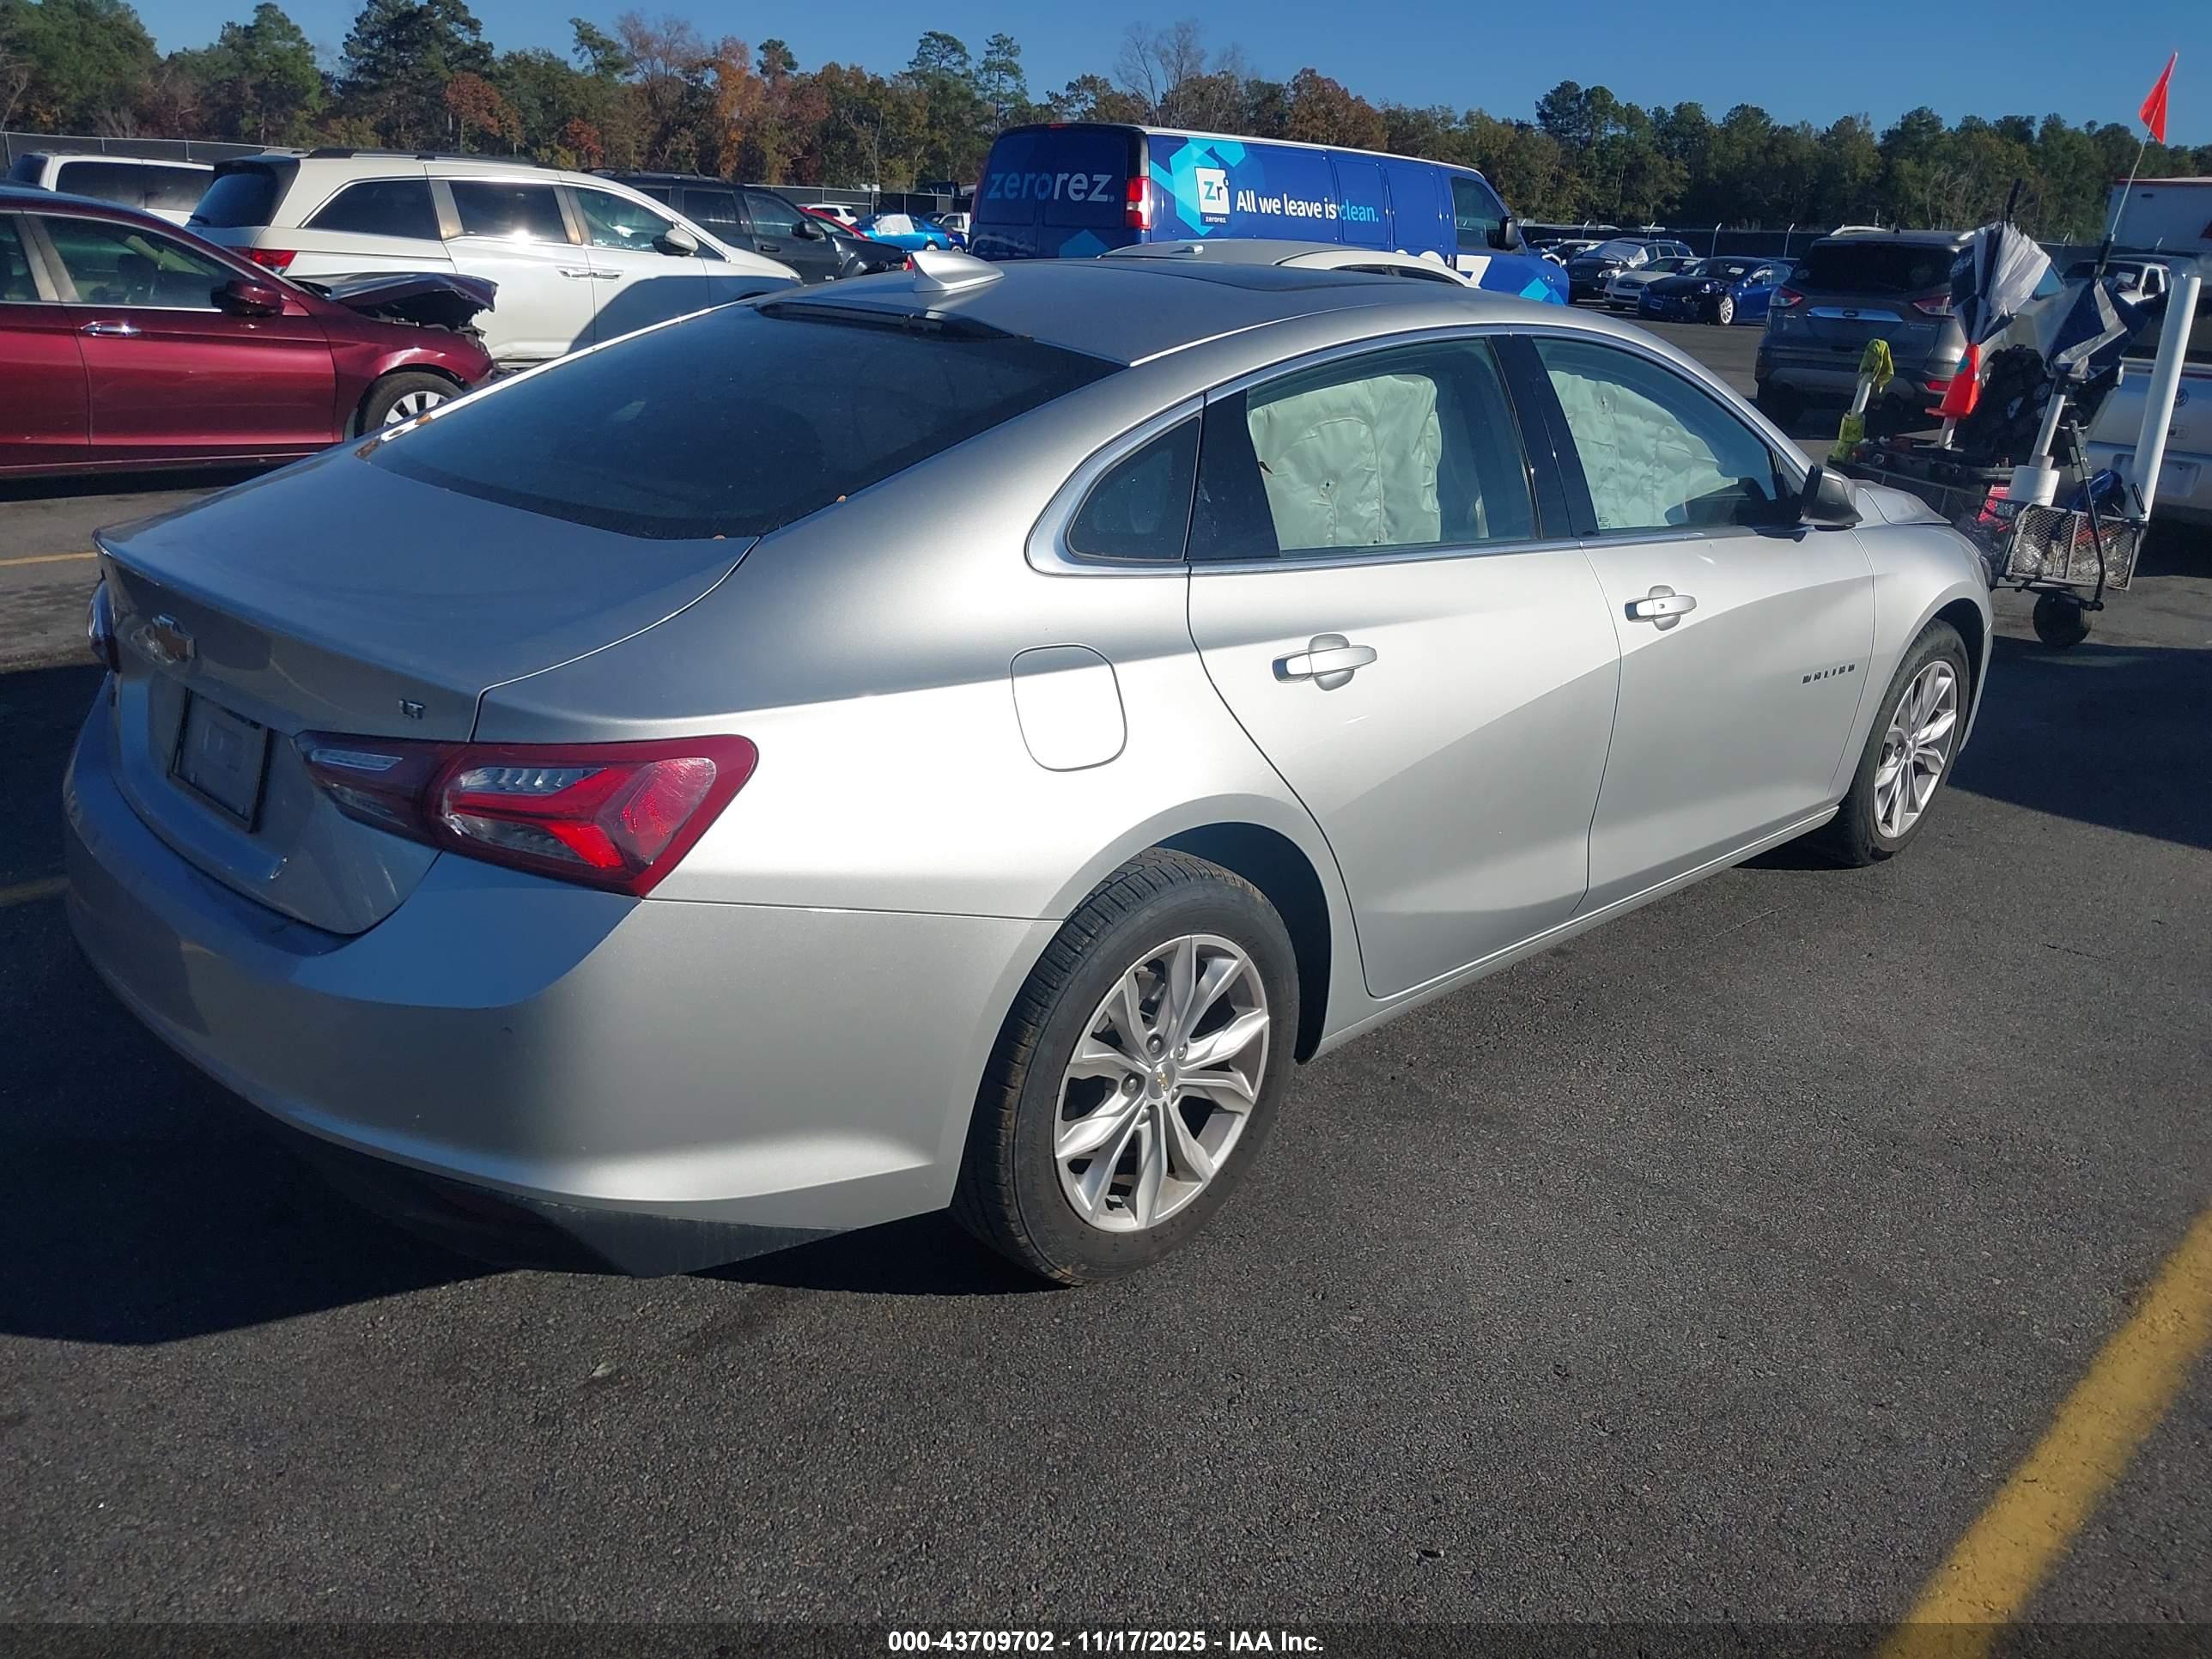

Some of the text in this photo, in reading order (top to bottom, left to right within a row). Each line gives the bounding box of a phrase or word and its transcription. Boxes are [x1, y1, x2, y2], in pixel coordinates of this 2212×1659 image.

[1237, 190, 1379, 223] All we leave is clean.
